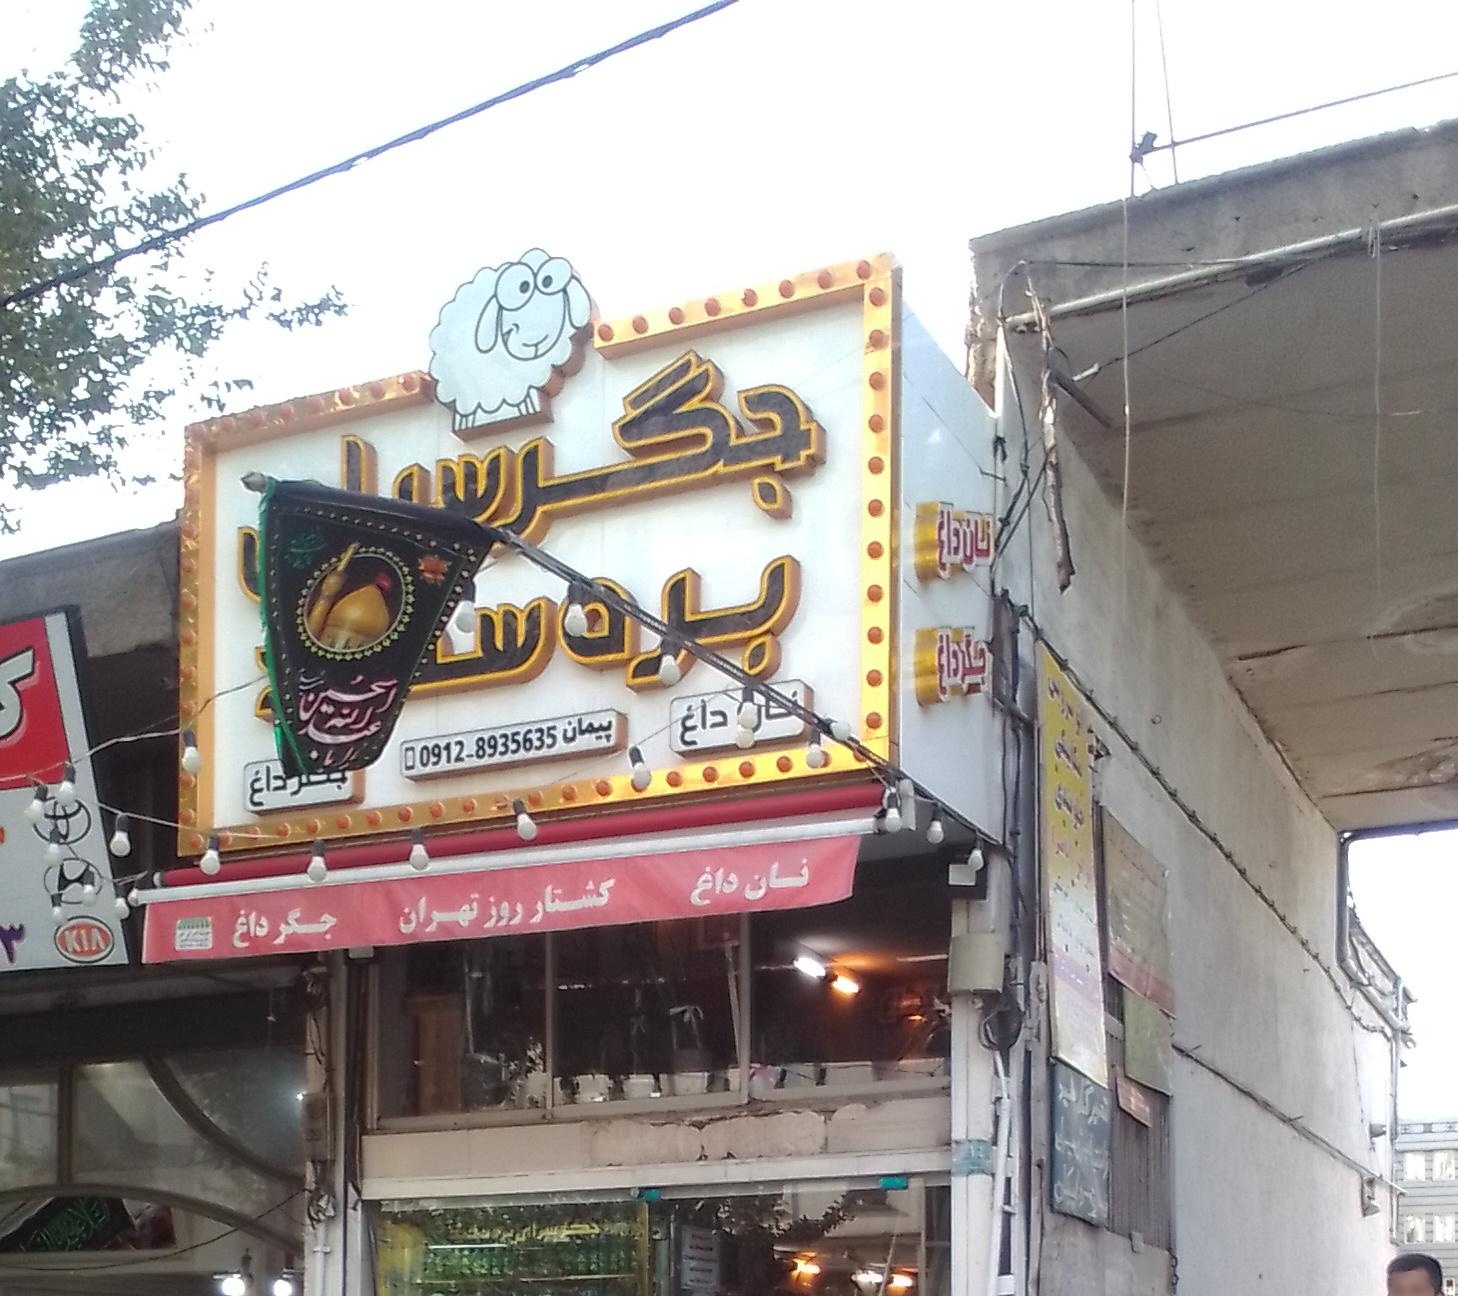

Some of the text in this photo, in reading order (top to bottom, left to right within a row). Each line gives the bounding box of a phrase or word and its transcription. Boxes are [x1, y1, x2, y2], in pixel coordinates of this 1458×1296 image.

[419, 716, 613, 769] پیمان 0912-8935635
[680, 698, 728, 746] داغ
[690, 858, 810, 906] نان داغ
[232, 909, 269, 948] داغ
[273, 908, 337, 945] جگر
[399, 879, 616, 934] کشتار روز تهران
[64, 929, 108, 953] KIA
